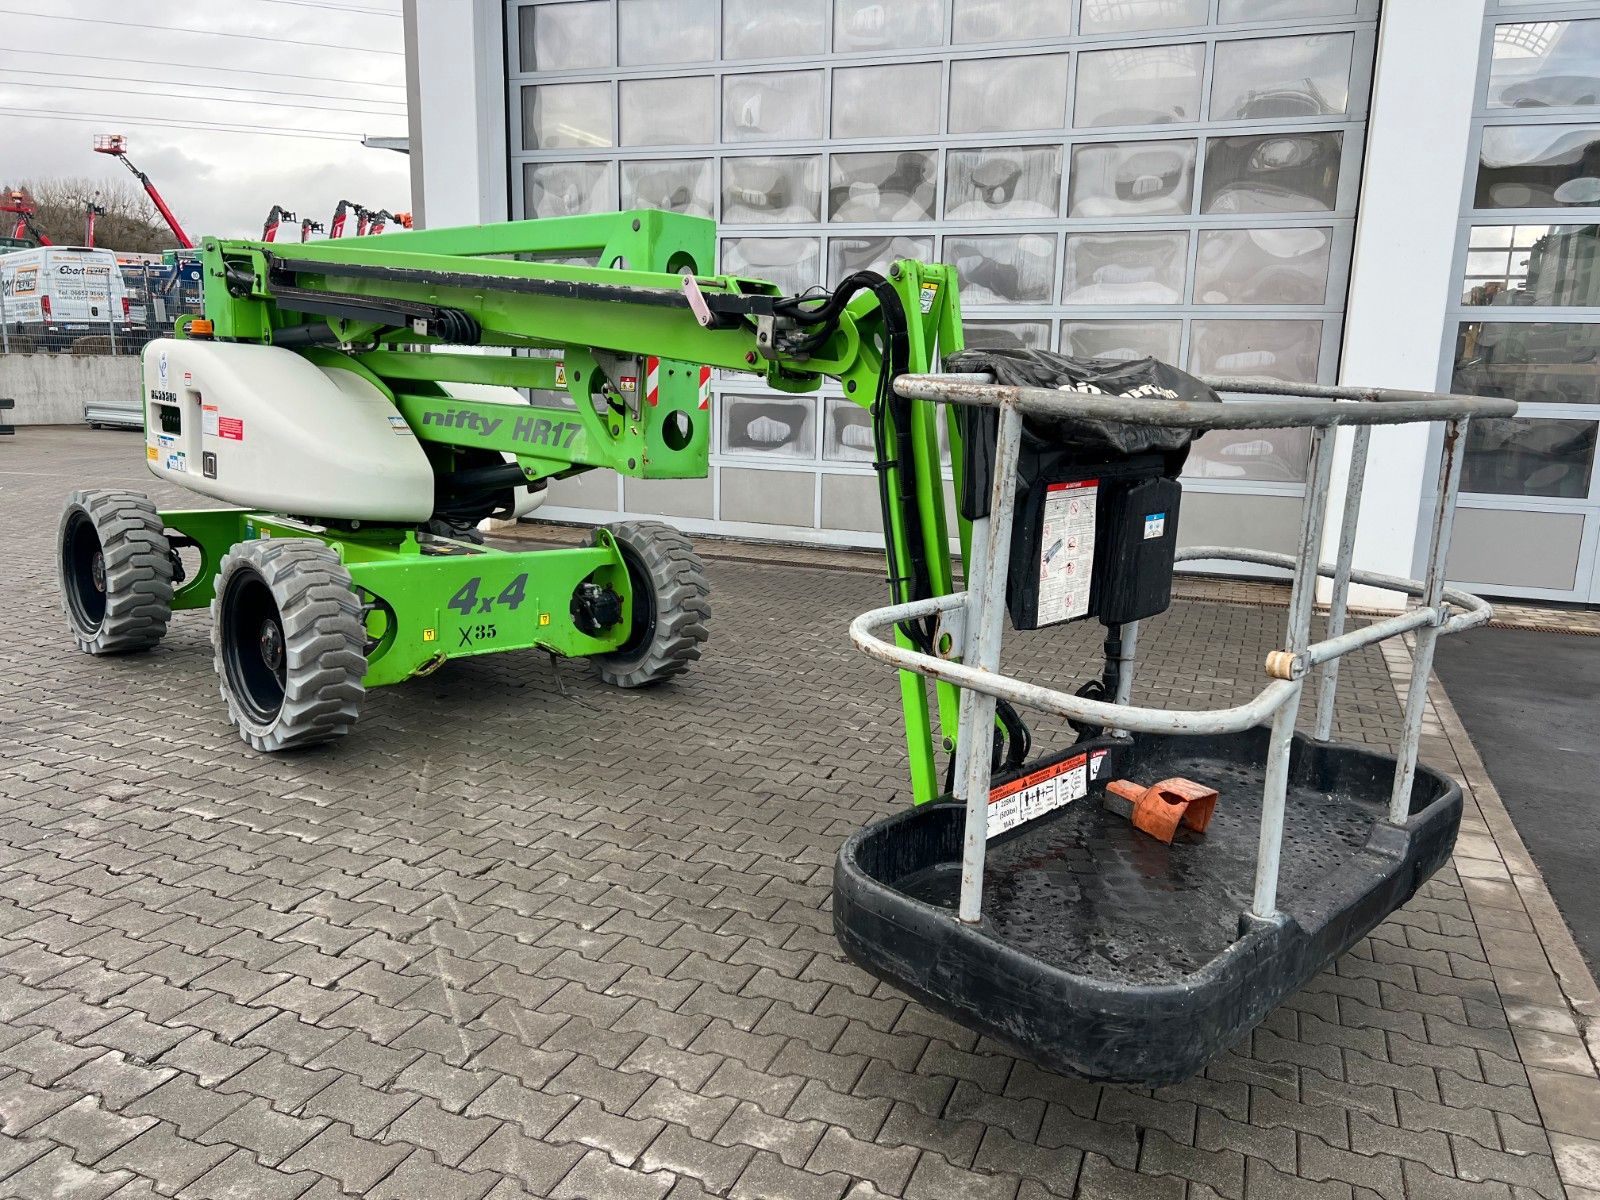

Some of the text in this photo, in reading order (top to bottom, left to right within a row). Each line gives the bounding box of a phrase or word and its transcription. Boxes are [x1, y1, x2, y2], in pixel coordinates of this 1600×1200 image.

[59, 265, 85, 276] Ebert
[423, 409, 582, 448] nifty HR17
[447, 573, 528, 615] 4x4
